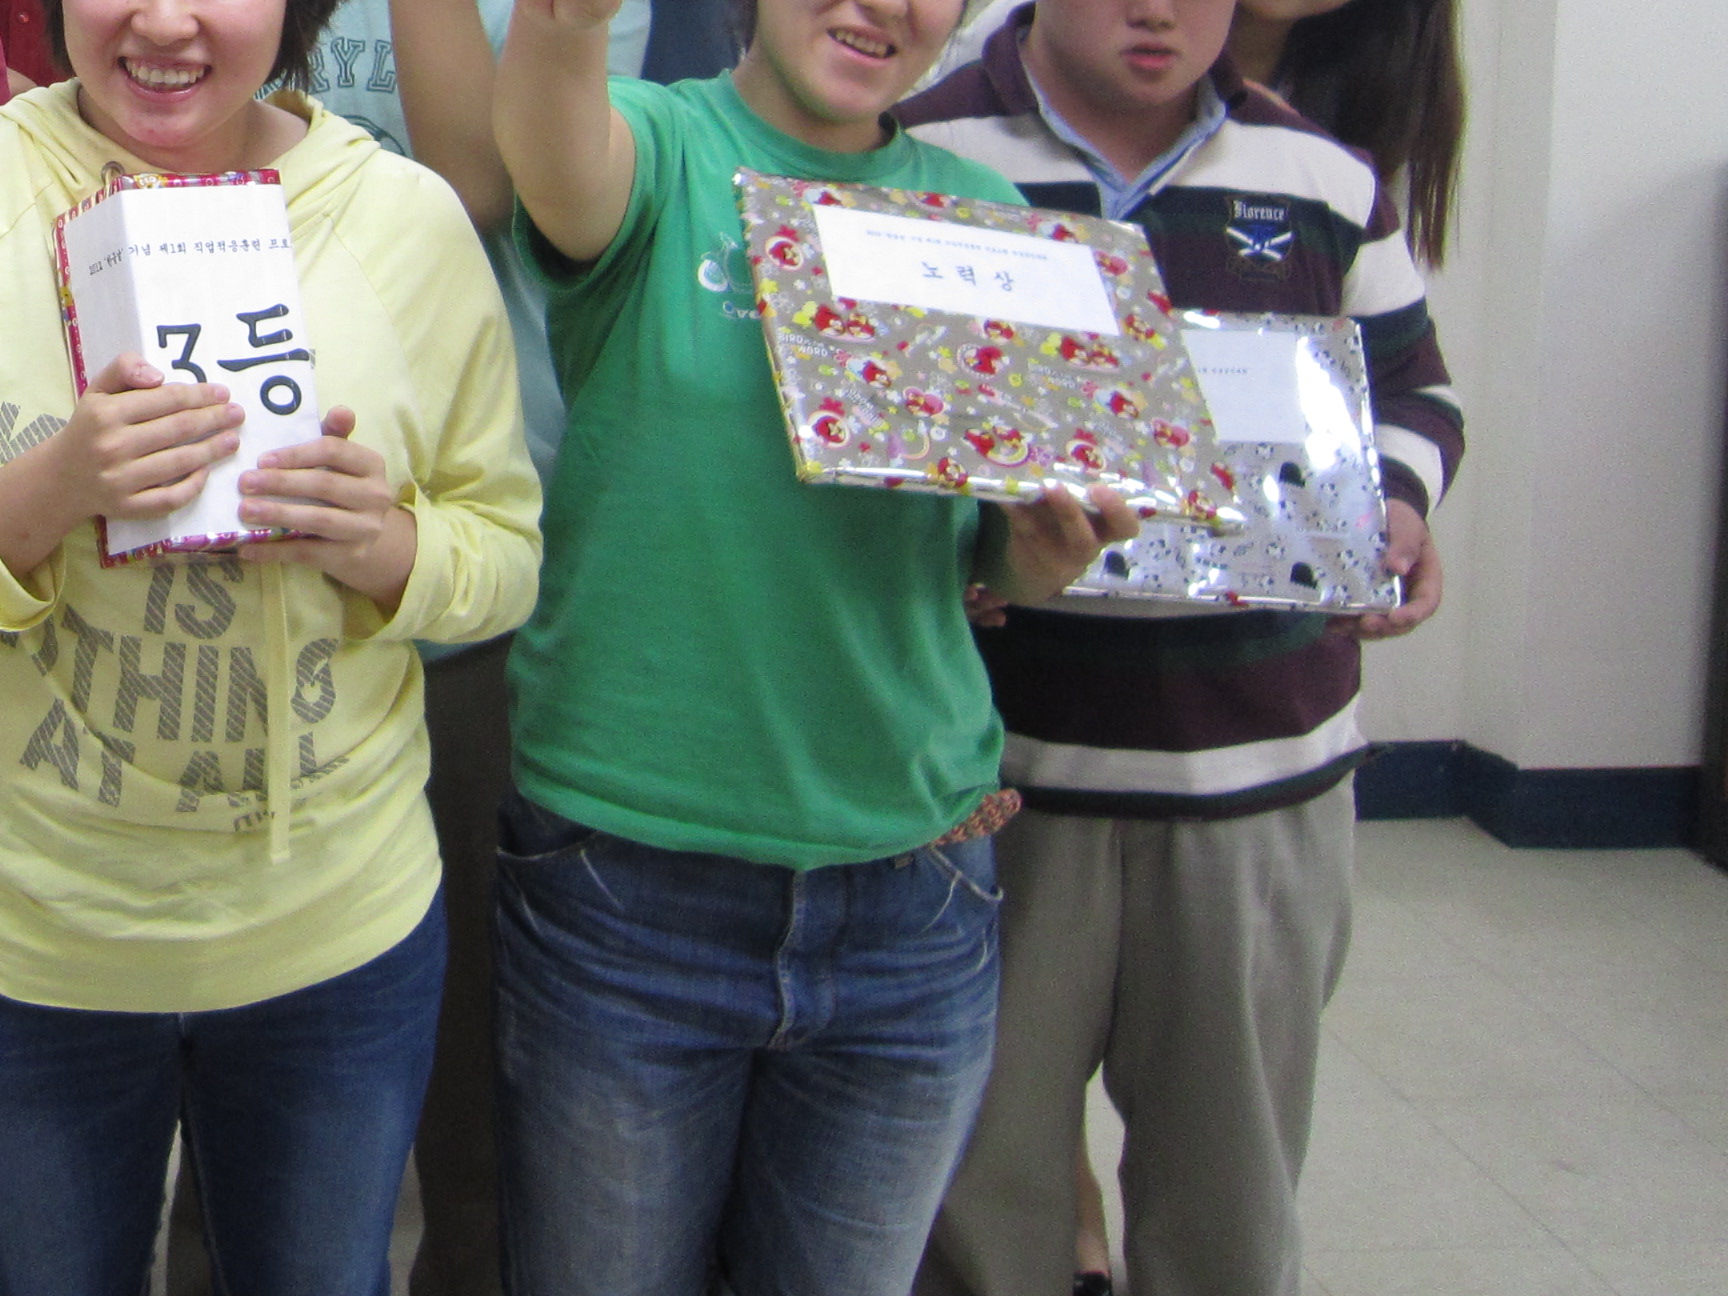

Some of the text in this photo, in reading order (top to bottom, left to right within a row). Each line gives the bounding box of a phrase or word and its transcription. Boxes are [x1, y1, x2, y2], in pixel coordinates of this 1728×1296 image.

[129, 243, 151, 256] 기념
[159, 241, 187, 255] 제1회
[268, 238, 292, 250] 프로
[156, 303, 310, 415] 3등
